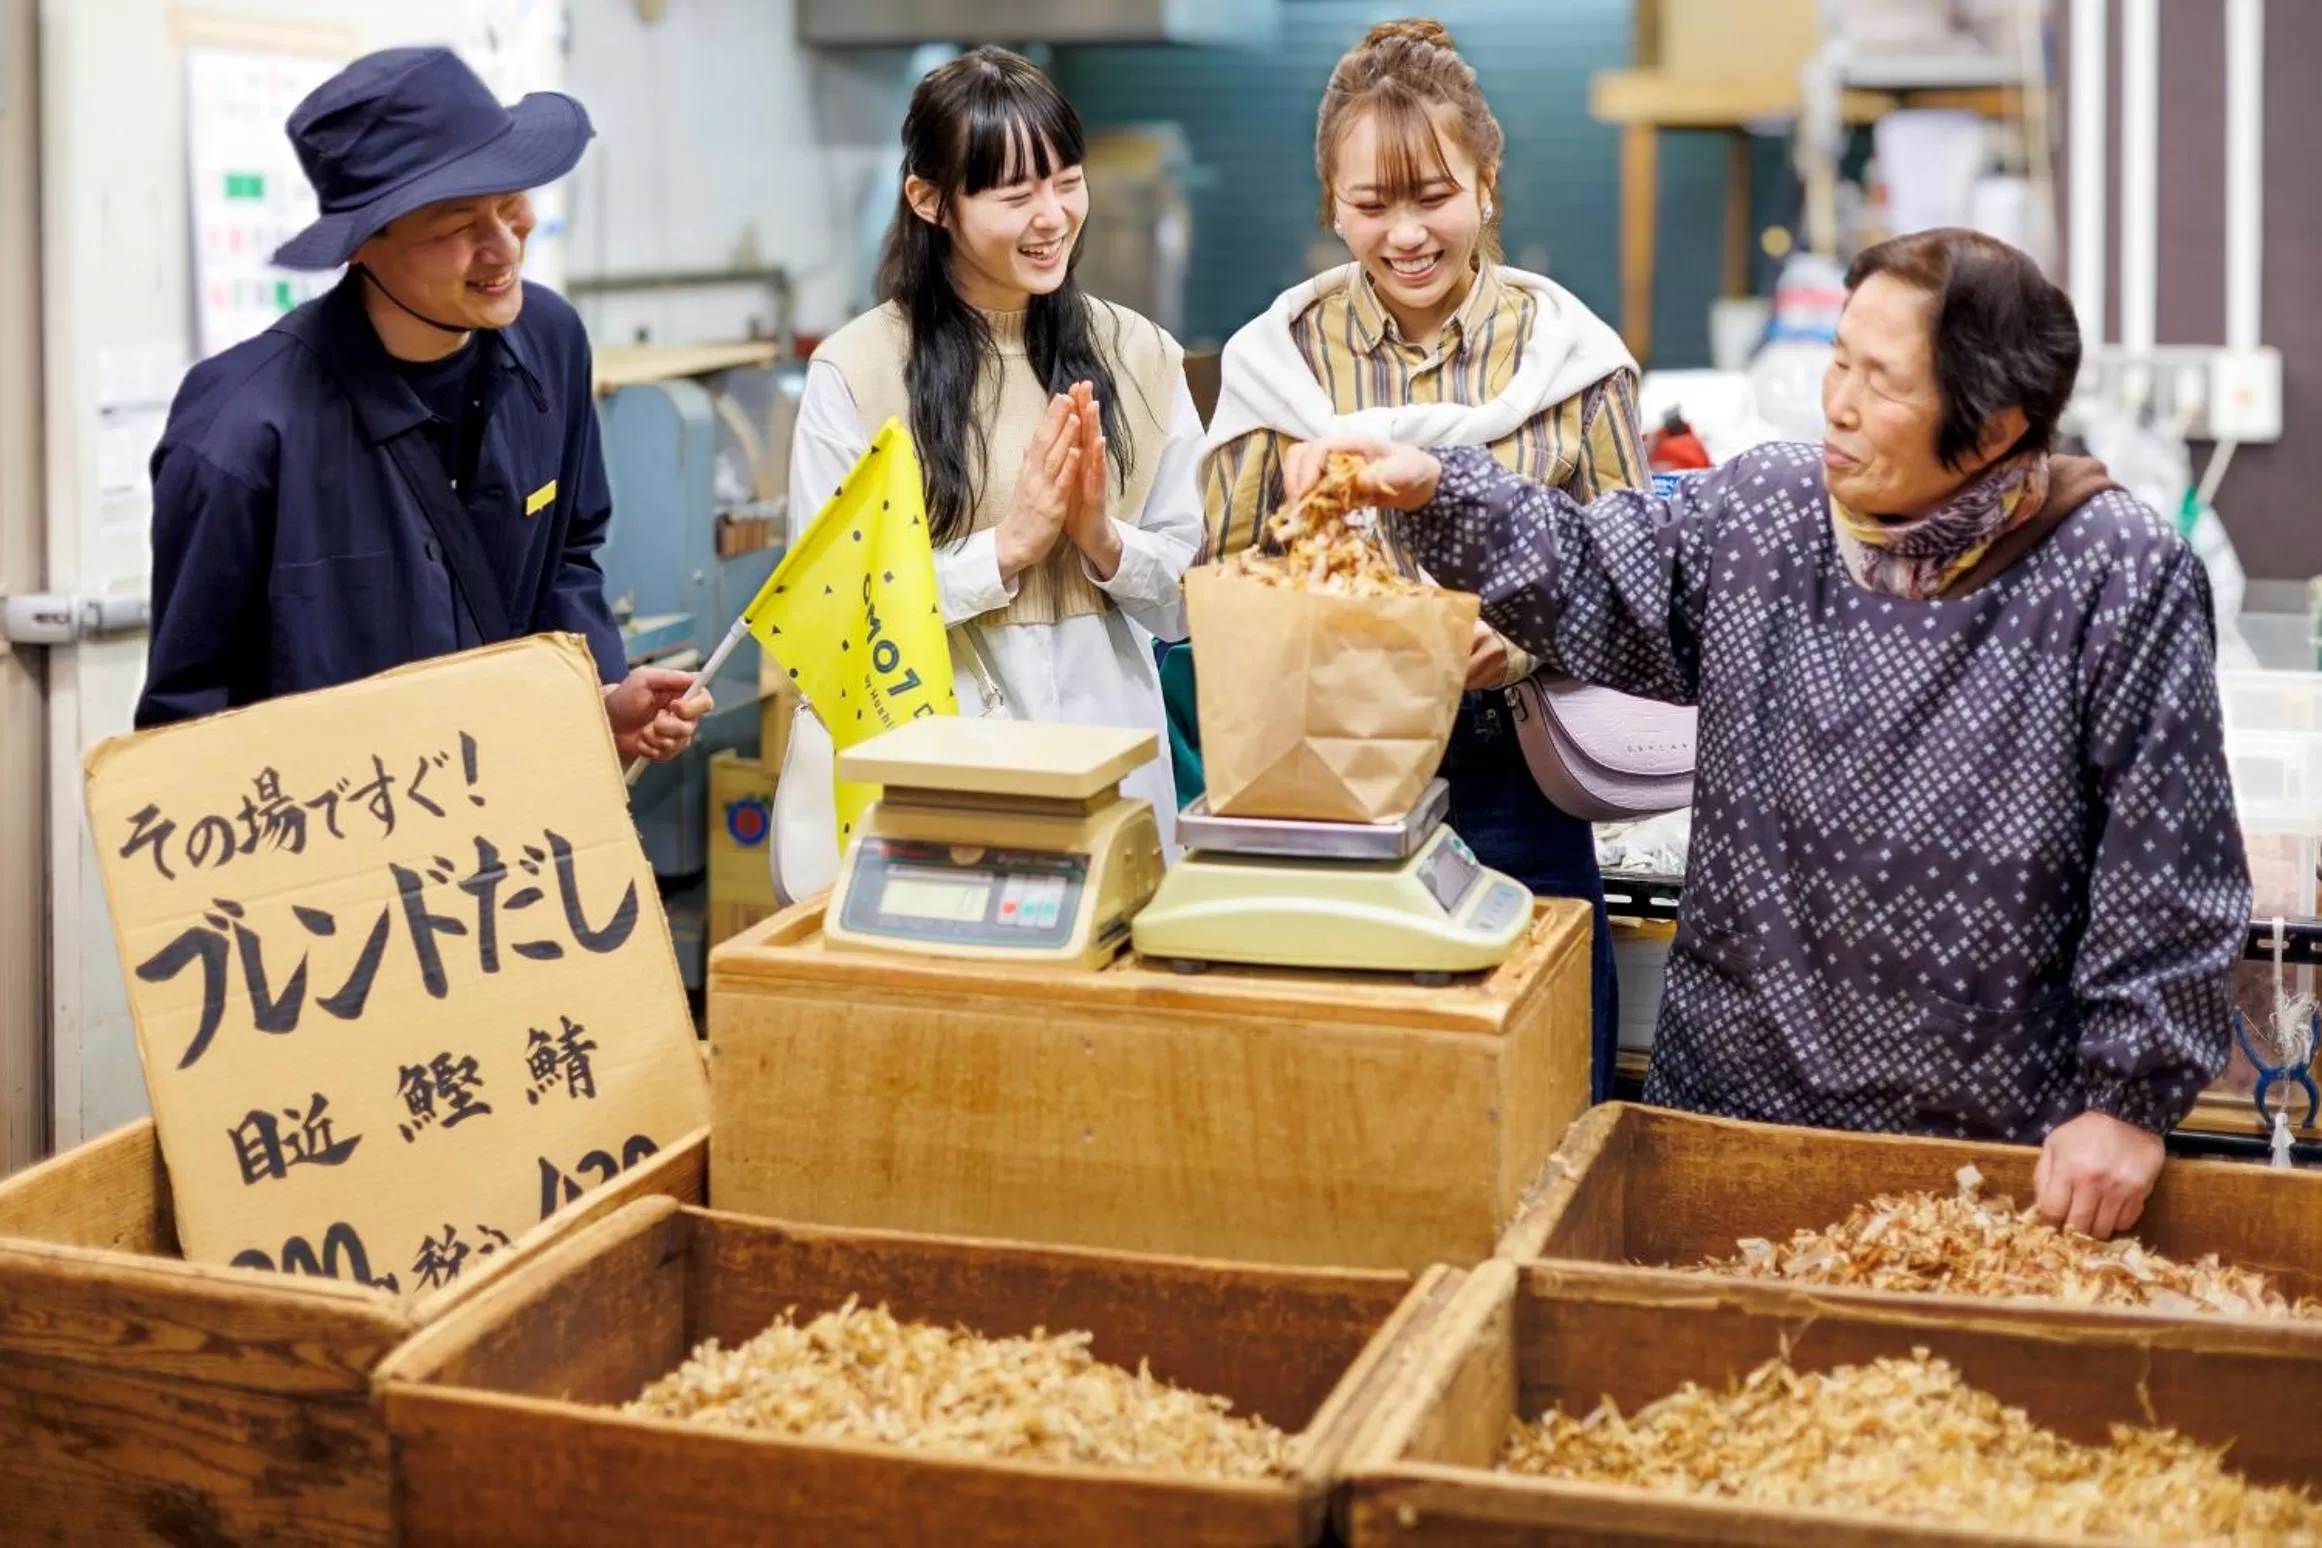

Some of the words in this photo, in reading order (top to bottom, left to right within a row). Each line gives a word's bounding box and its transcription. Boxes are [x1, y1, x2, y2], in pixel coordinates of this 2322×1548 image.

[119, 731, 485, 881] その場ですぐ!
[135, 828, 639, 1070] ブレンドだし
[226, 1092, 363, 1186] 目近
[395, 1051, 493, 1143] 鰹
[524, 1015, 598, 1105] 鯖
